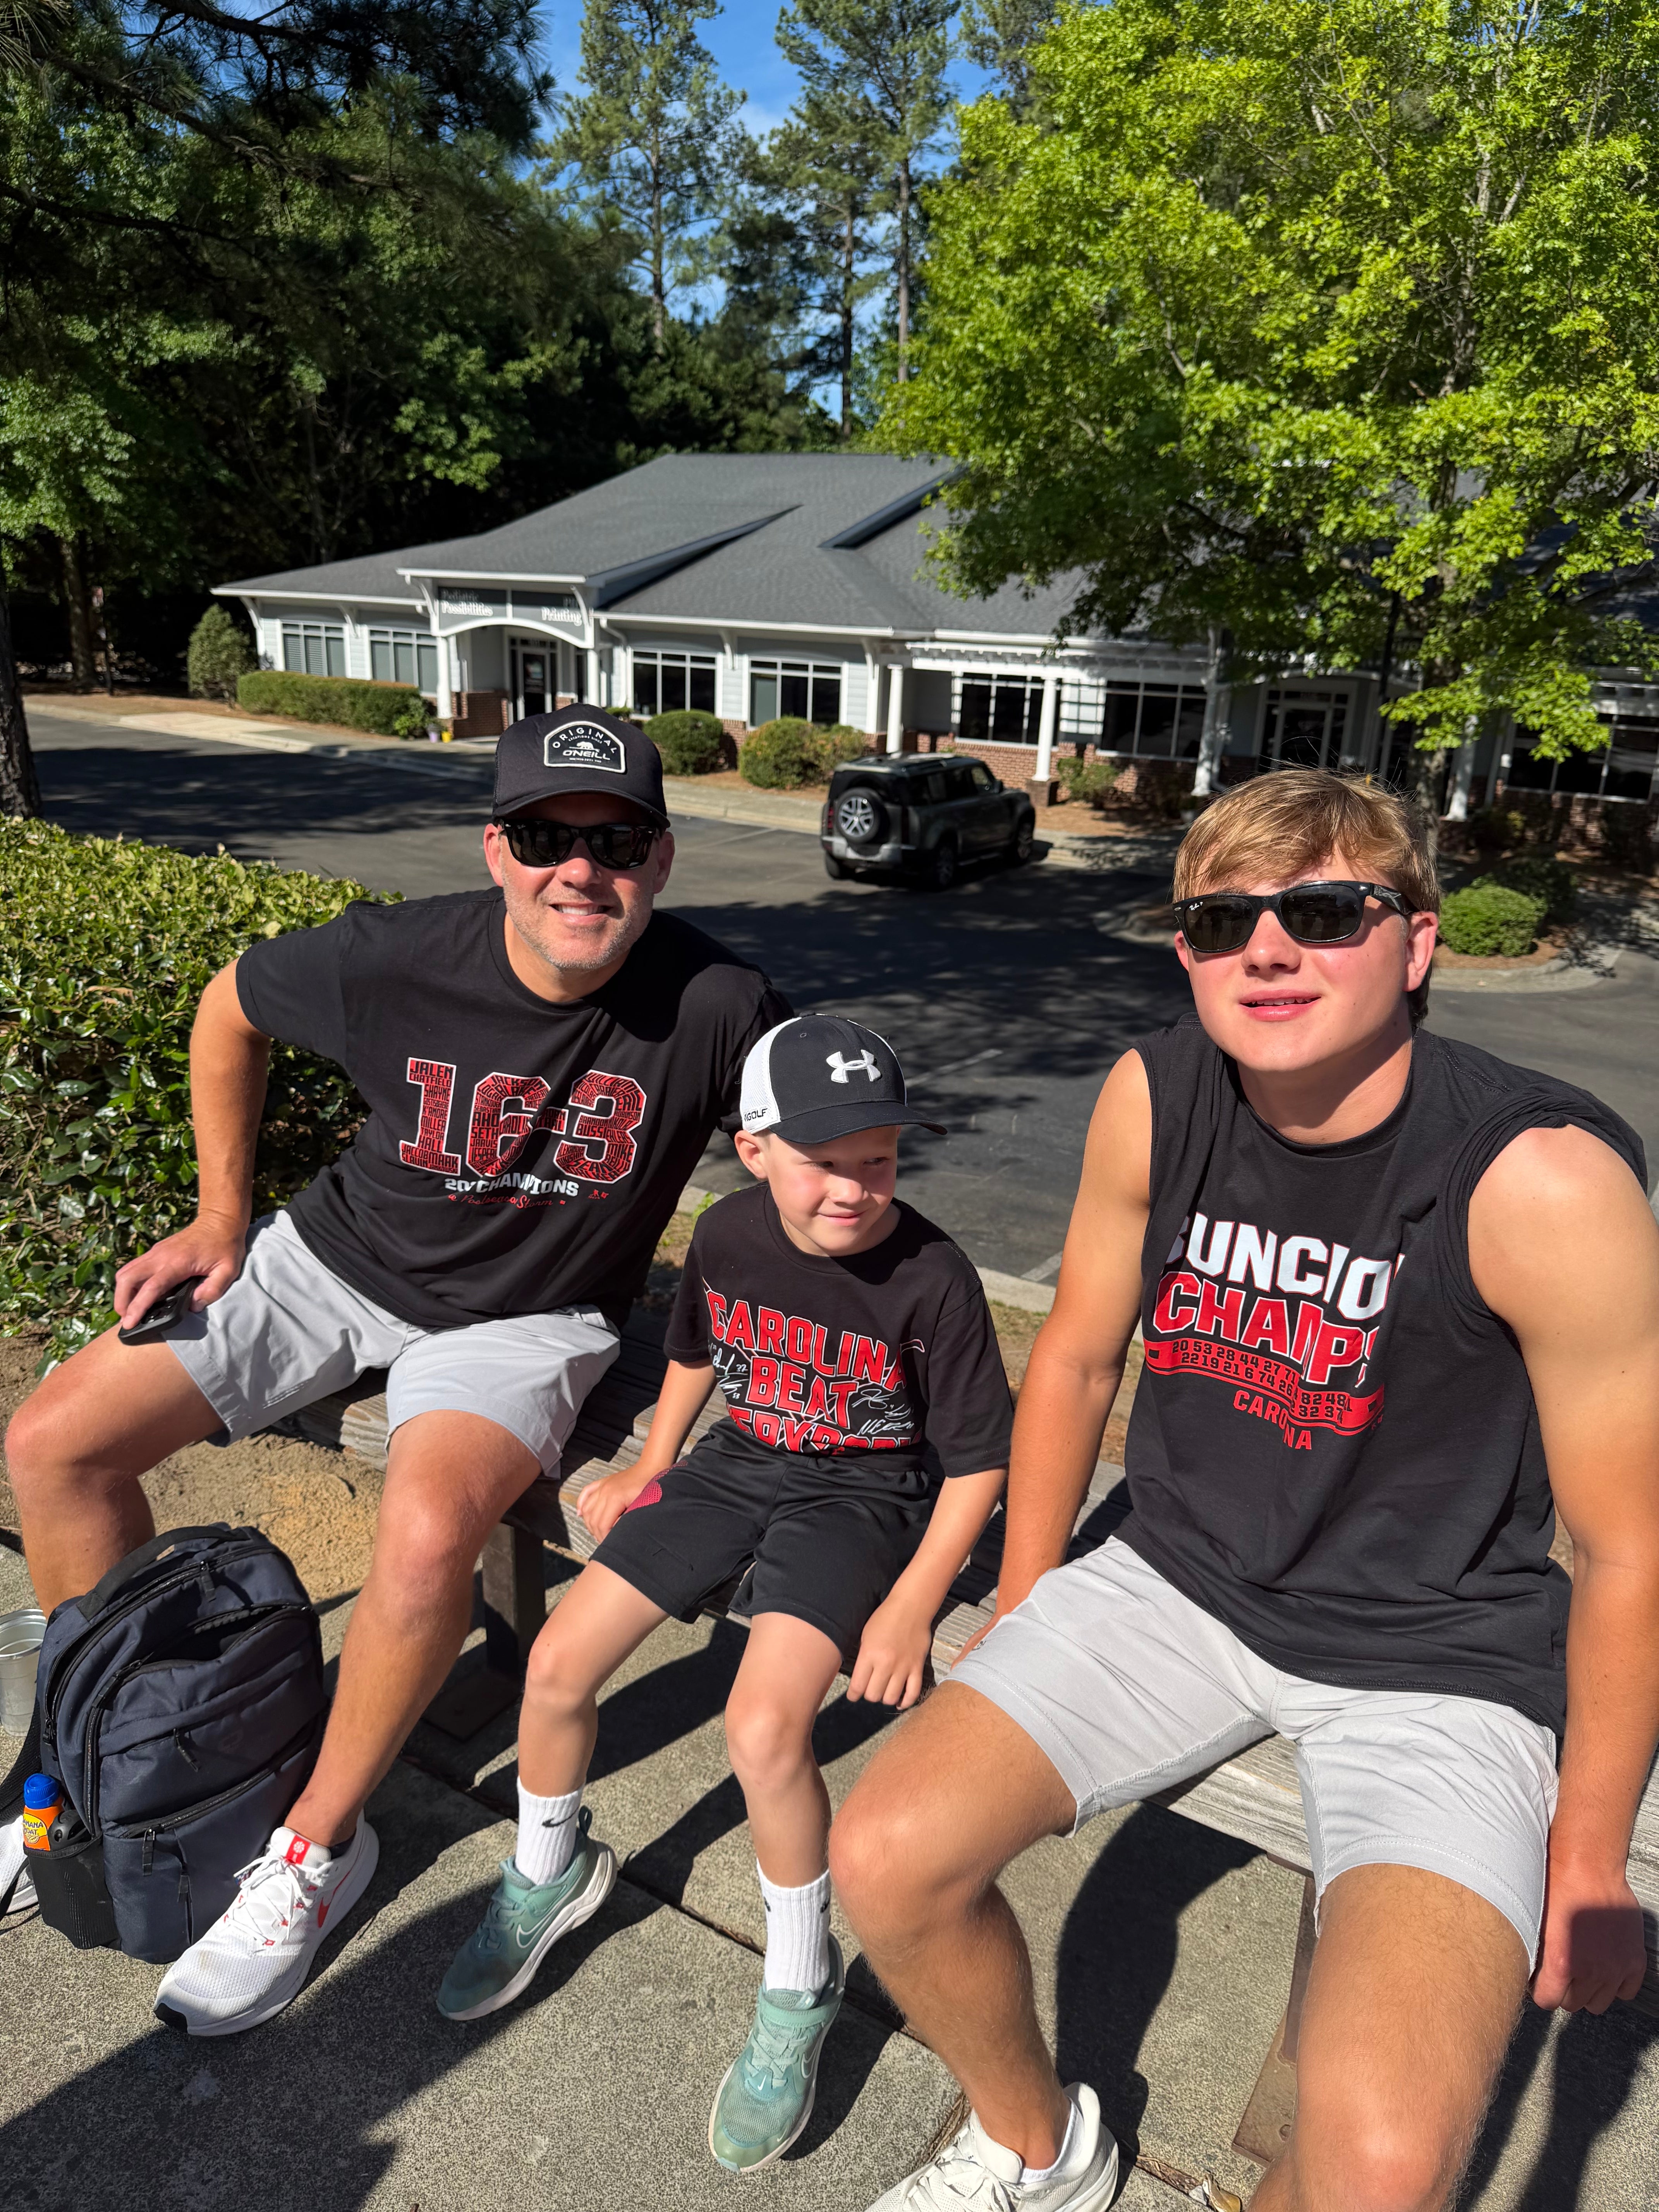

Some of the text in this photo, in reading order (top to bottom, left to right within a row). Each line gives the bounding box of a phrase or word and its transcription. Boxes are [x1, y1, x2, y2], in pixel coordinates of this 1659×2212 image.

[441, 600, 493, 617] Possibilities
[541, 607, 582, 627] Printing
[553, 727, 617, 753] ORIGINAL
[563, 750, 610, 760] O'NEILL
[410, 1061, 453, 1079] JALEN
[409, 1073, 452, 1087] CHATFIELD
[491, 1075, 546, 1090] JACKSON
[586, 1072, 638, 1093] WILLIAM
[424, 1084, 451, 1101] SHAYNE
[477, 1081, 503, 1102] LOGAN
[616, 1090, 642, 1111] ERIC
[472, 1112, 500, 1127] AHO
[579, 1115, 608, 1128] BRANDON
[747, 1108, 768, 1121] GOLF
[421, 1116, 447, 1132] MILLER
[575, 1123, 607, 1139] BUSSI
[421, 1127, 444, 1140] TAYLOR
[471, 1127, 499, 1139] SETH
[606, 1128, 634, 1144] EHLERS
[402, 1144, 429, 1159] JACCOB
[417, 1135, 442, 1154] HALL
[470, 1139, 498, 1148] JARVIS
[402, 1153, 428, 1168] SLAVIN
[428, 1152, 459, 1168] MARK
[607, 1143, 634, 1162] MIKE
[567, 1158, 614, 1174] SEAN
[475, 1173, 579, 1197] CHAMPIONS
[707, 1290, 907, 1391] CAROLINA
[1172, 1340, 1188, 1354] 20
[1193, 1341, 1212, 1355] 53
[1216, 1346, 1235, 1361] 28
[1239, 1353, 1259, 1369] 44
[1264, 1360, 1281, 1376] 27
[1285, 1367, 1296, 1385] 71
[1301, 1392, 1322, 1405] 82
[1325, 1393, 1346, 1407] 48
[745, 1356, 859, 1429] BEAT
[1181, 1352, 1199, 1364] 22
[1201, 1355, 1219, 1369] 19
[1223, 1361, 1240, 1376] 21
[1244, 1367, 1254, 1379] 6
[1259, 1370, 1275, 1387] 74
[1278, 1379, 1292, 1397] 26
[1298, 1405, 1319, 1417] 32
